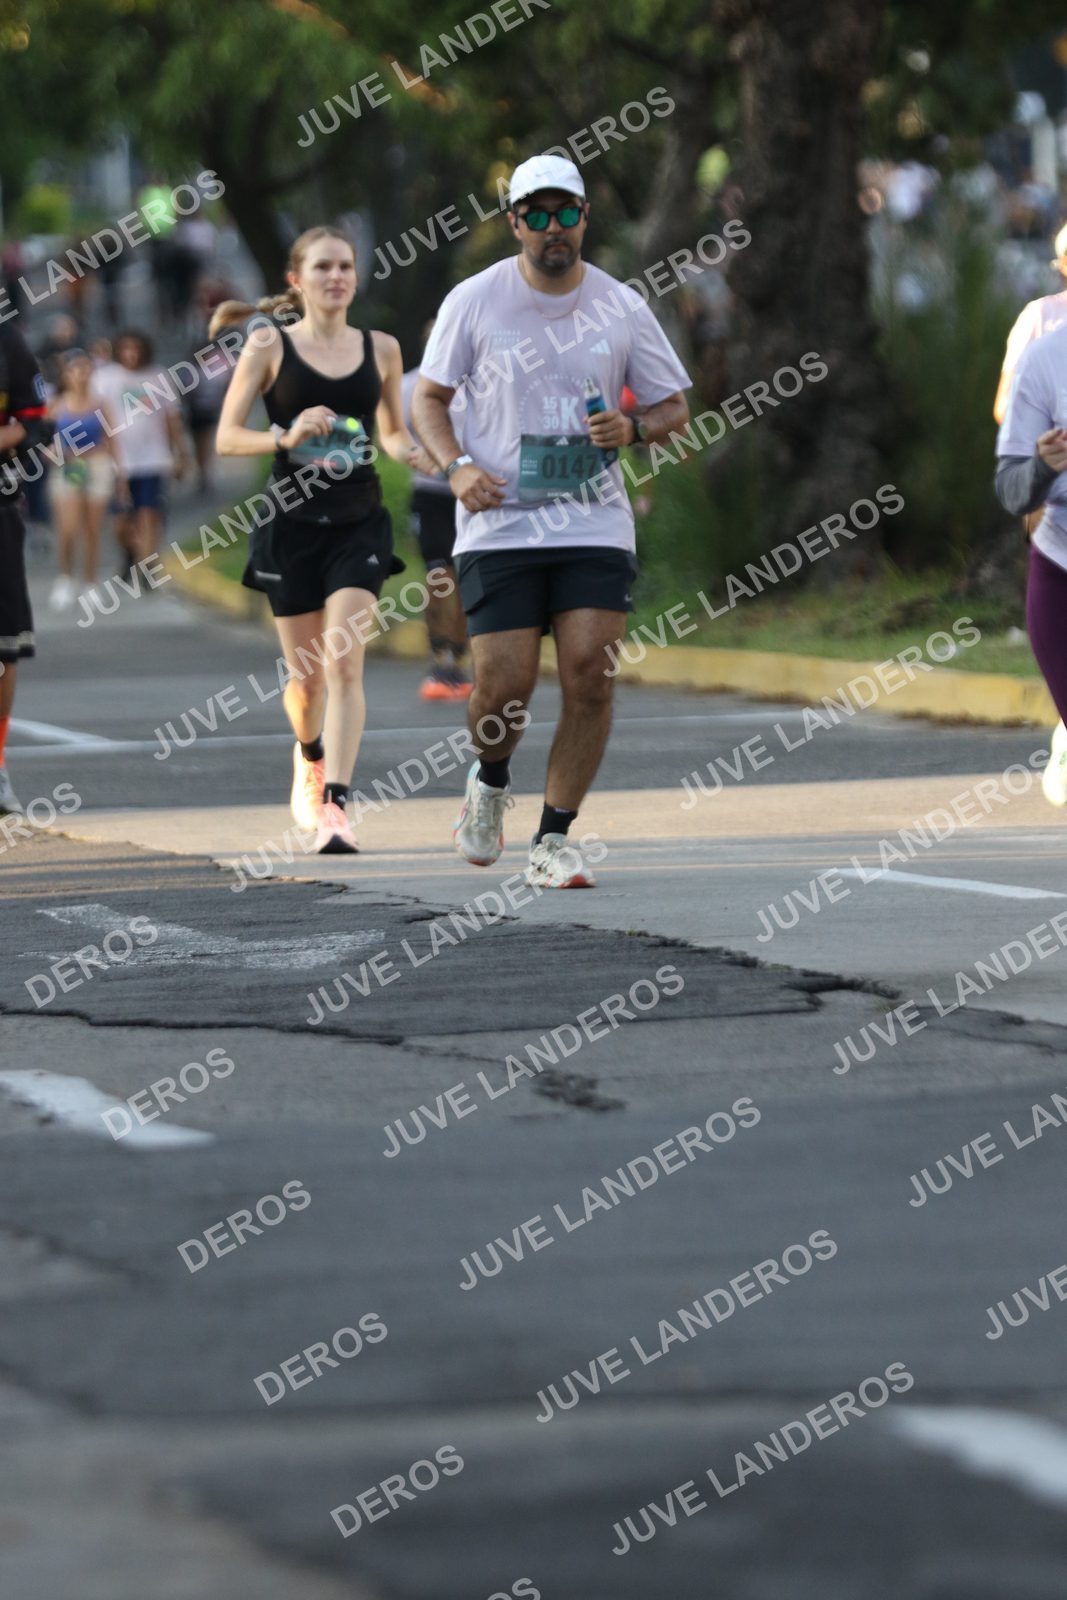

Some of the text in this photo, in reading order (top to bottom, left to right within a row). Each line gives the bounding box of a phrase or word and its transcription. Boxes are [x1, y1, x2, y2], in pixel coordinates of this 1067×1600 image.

[543, 395, 557, 410] 15
[560, 396, 581, 431] K
[543, 415, 559, 430] 30
